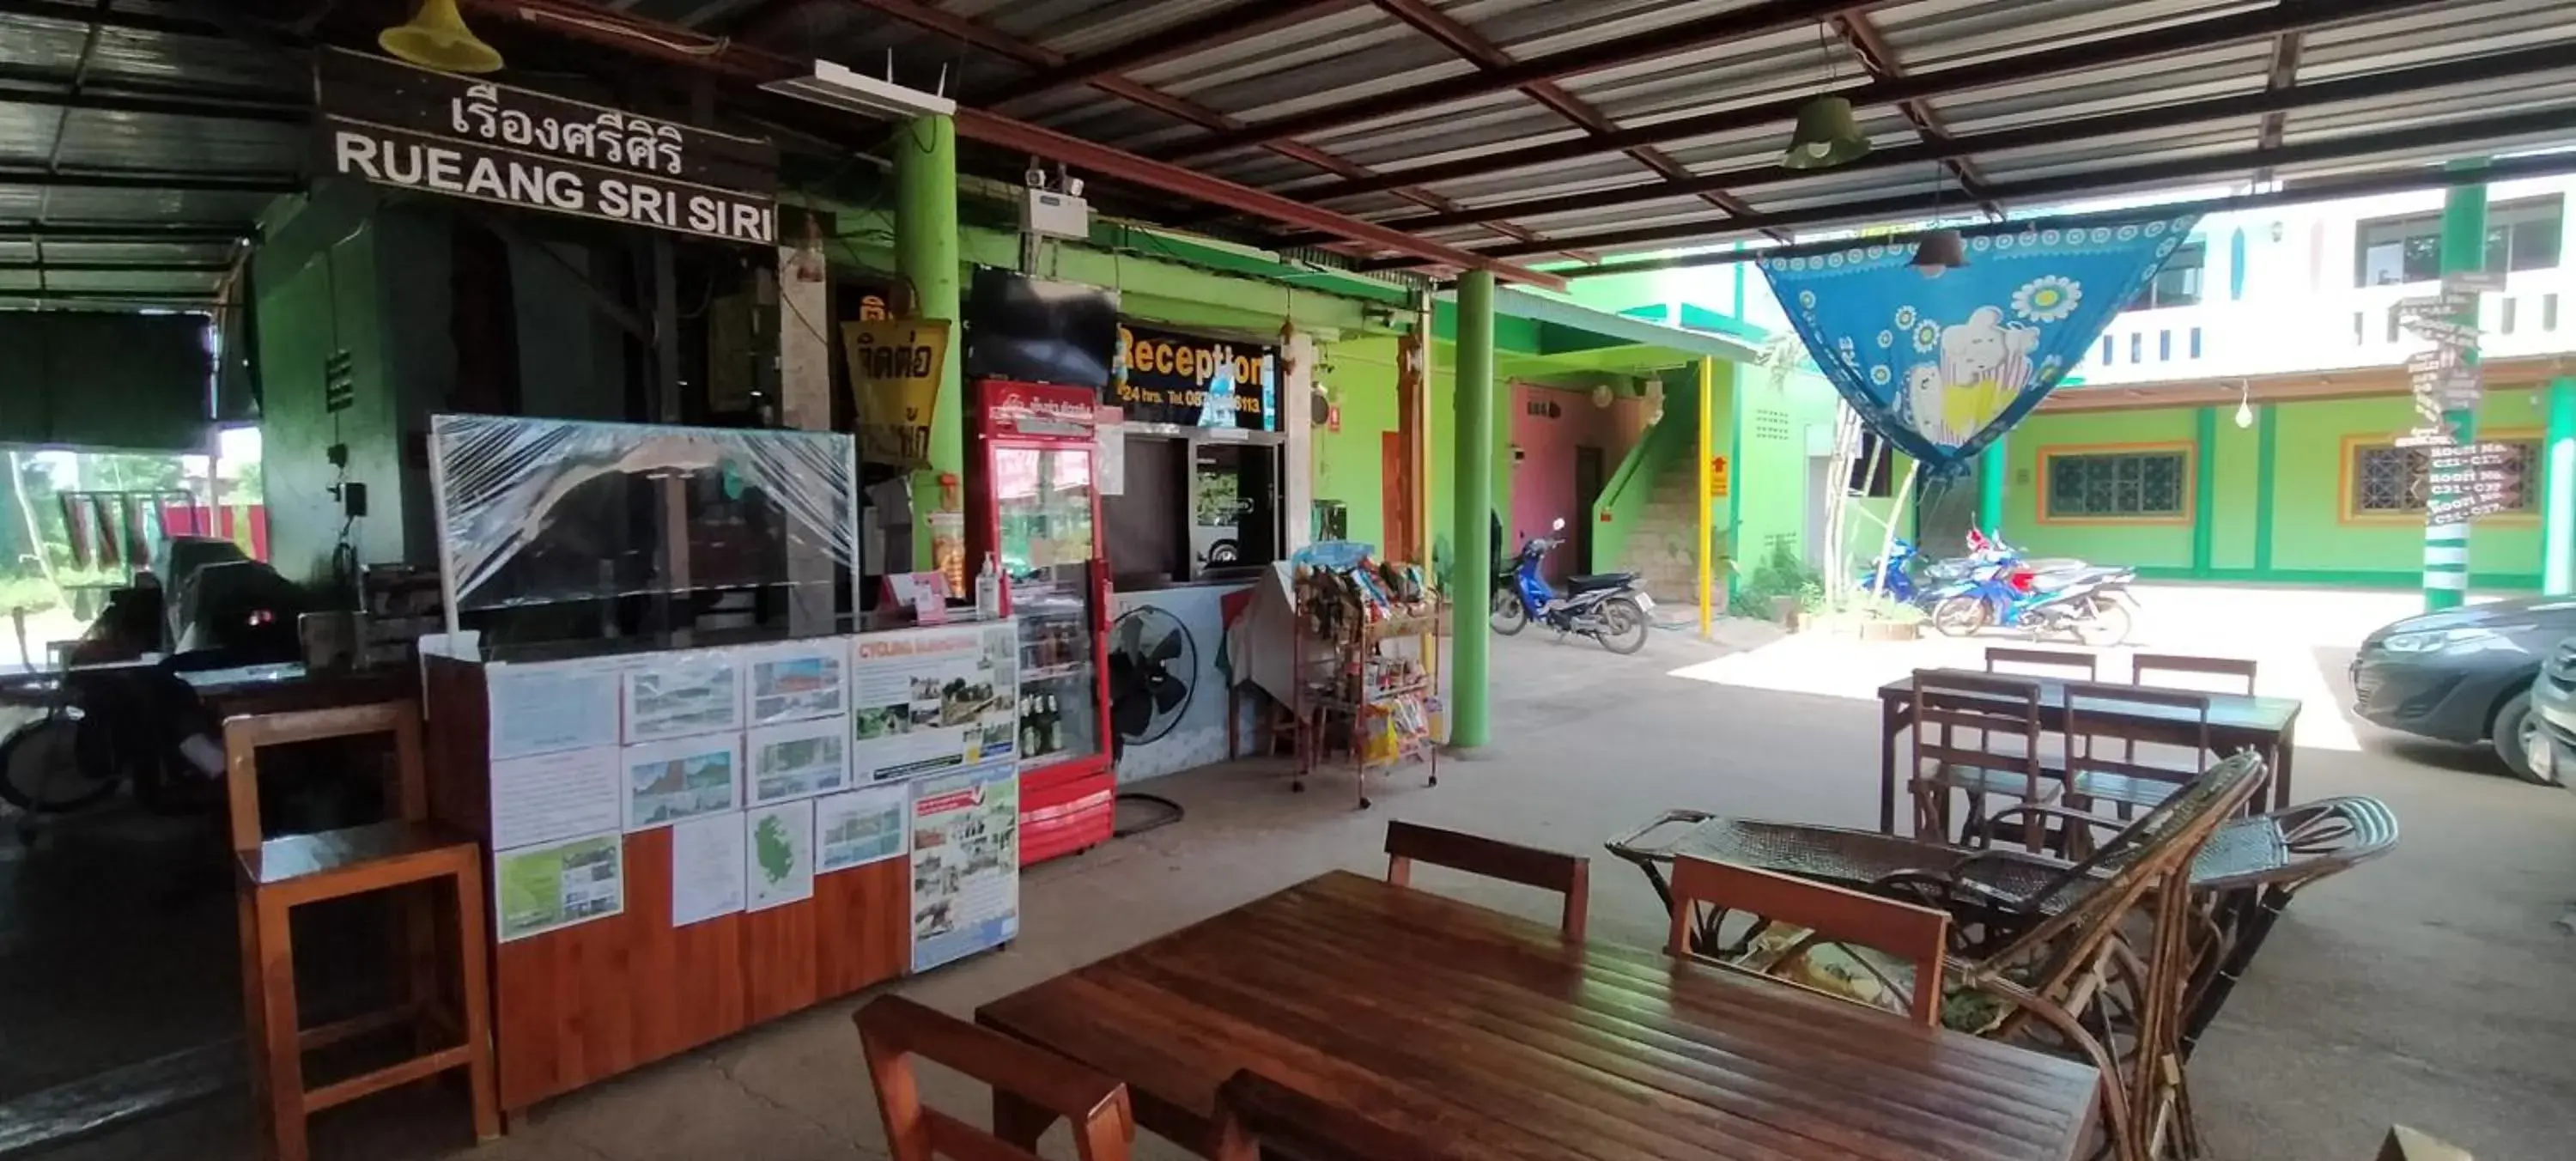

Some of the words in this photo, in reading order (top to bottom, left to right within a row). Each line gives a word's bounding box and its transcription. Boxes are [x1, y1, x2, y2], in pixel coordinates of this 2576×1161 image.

[336, 131, 585, 210] RUEANG
[598, 179, 677, 227] SRI
[688, 195, 772, 242] SIRI
